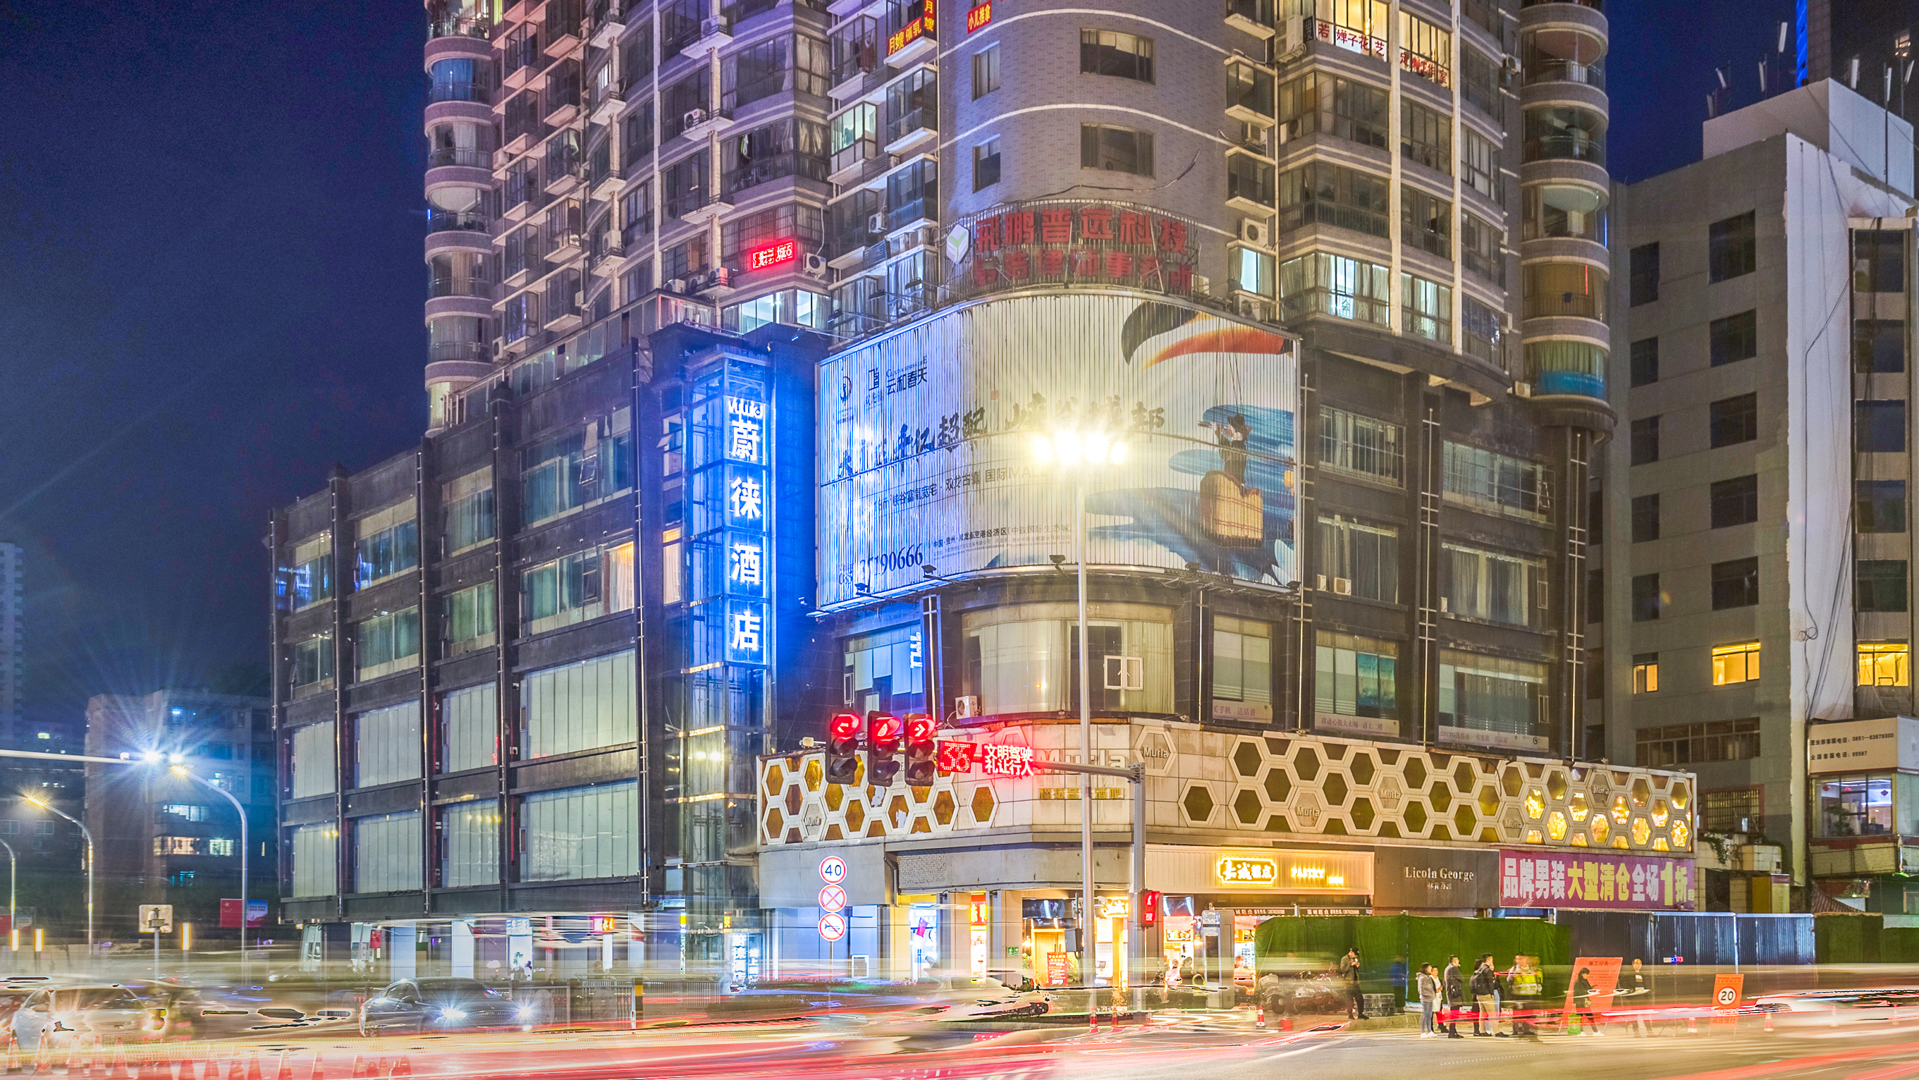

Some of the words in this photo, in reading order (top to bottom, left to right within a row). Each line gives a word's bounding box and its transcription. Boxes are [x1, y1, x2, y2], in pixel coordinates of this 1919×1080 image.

[886, 367, 928, 395] 云和春天
[730, 418, 761, 651] 蔚徕酒店
[984, 743, 1034, 762] 文明驾驶
[984, 759, 1034, 776] 礼让行人
[825, 864, 842, 877] 40
[1440, 867, 1474, 882] George
[1721, 991, 1734, 1001] 20
